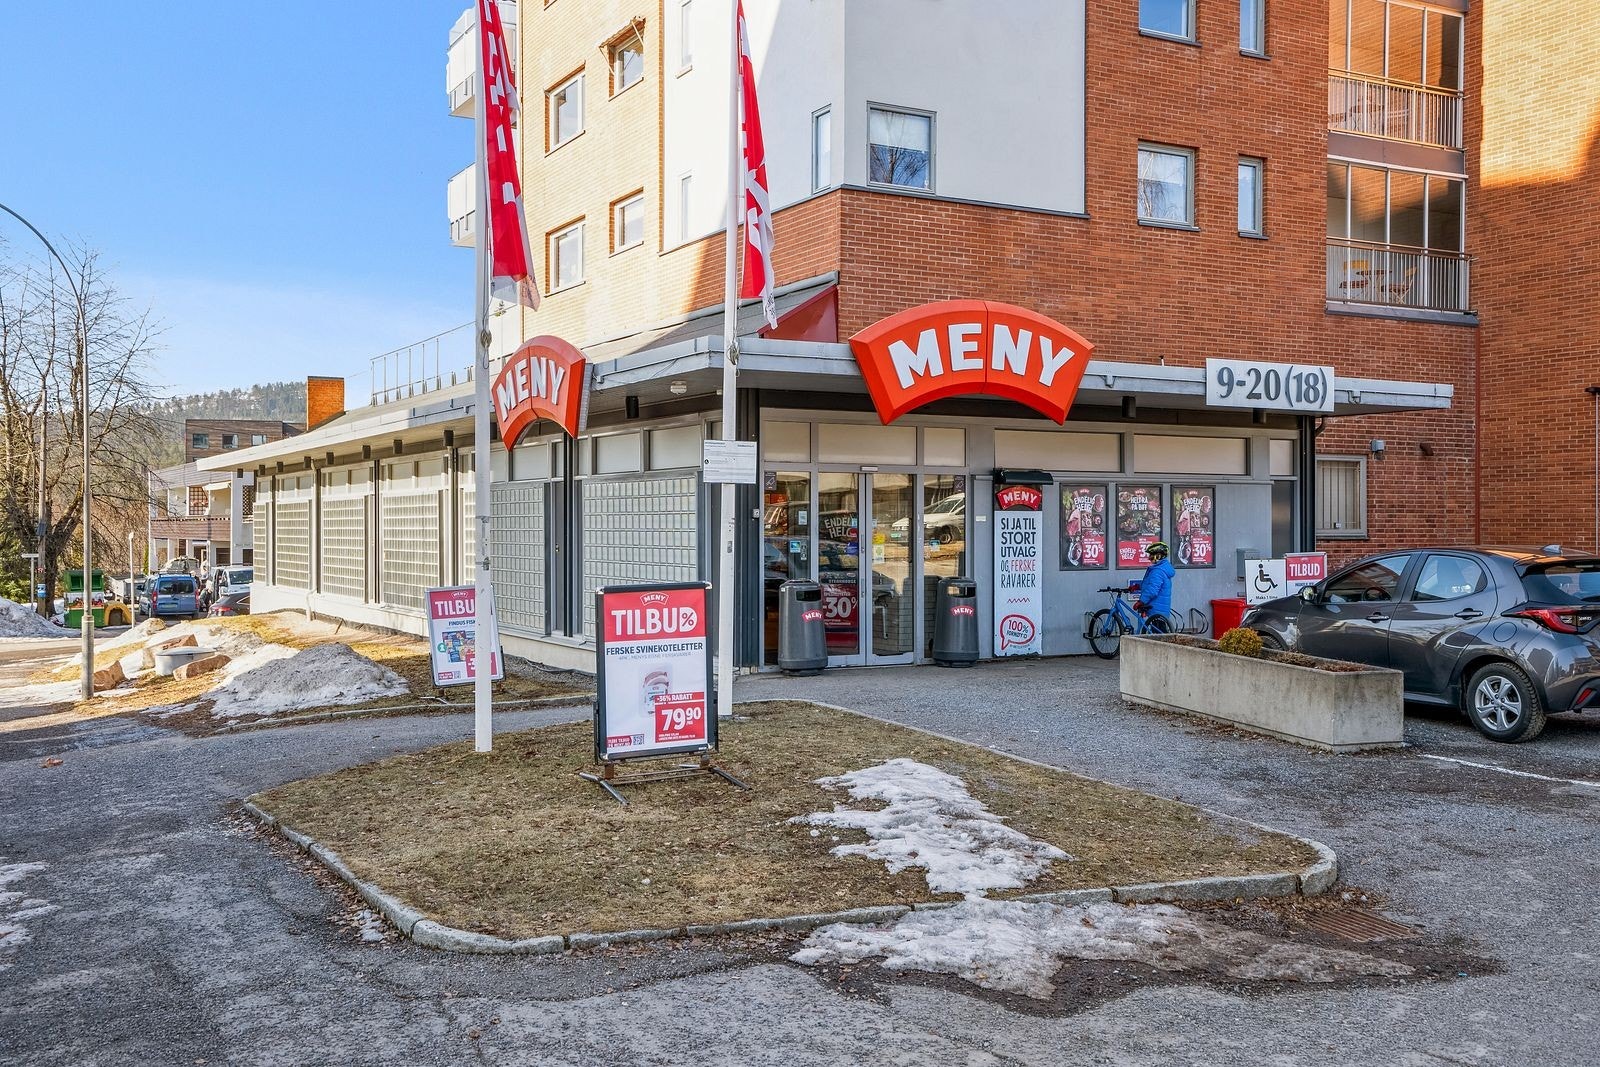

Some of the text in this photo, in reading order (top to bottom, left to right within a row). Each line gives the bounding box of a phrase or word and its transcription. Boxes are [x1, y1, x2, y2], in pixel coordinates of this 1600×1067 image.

[888, 323, 1075, 389] MENY
[496, 356, 565, 422] MENY
[1217, 365, 1327, 409] 9-20(18)
[1003, 491, 1038, 503] MENY
[1001, 518, 1036, 530] SI JA TIL
[1001, 532, 1036, 545] STORT
[1000, 546, 1036, 557] UTVALG
[1083, 543, 1104, 558] -30%
[1193, 543, 1211, 557] -30%
[1011, 559, 1036, 572] FERSKE
[1289, 563, 1320, 576] TILBUD
[643, 594, 665, 602] MENY
[435, 599, 475, 616] TILBU
[1009, 620, 1028, 633] 100%
[606, 642, 703, 655] FERSKE SVINEKOTELETTER
[662, 707, 701, 731] 79 90
